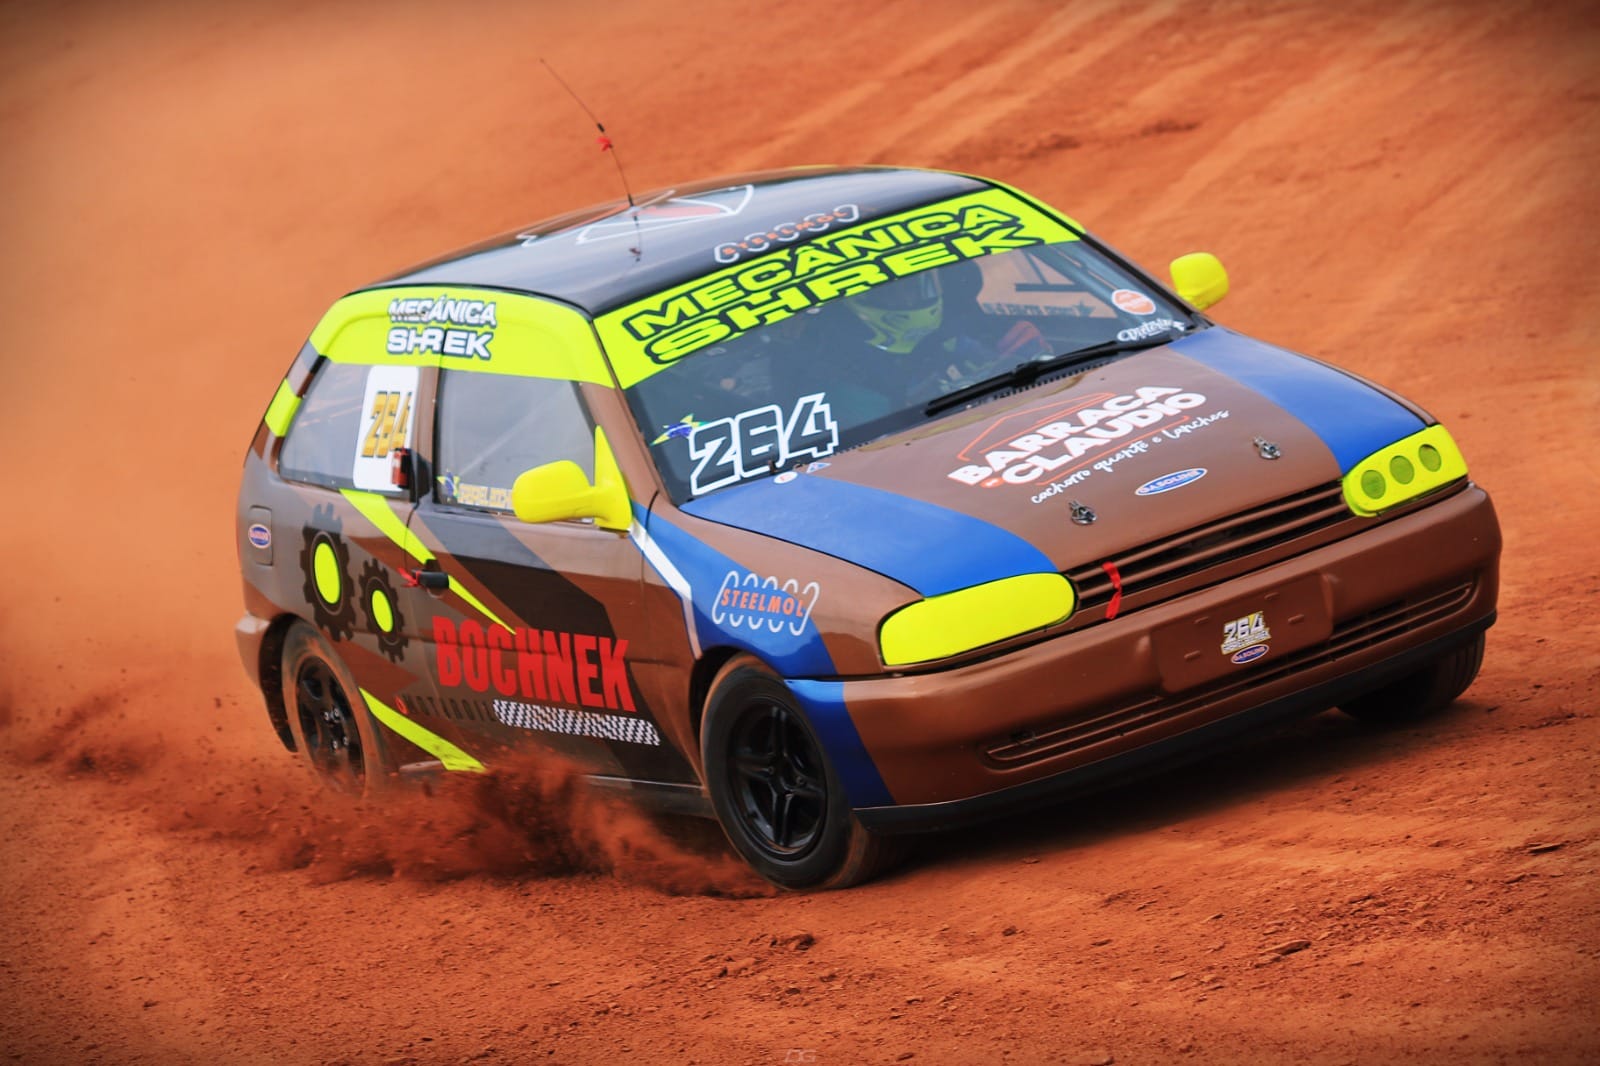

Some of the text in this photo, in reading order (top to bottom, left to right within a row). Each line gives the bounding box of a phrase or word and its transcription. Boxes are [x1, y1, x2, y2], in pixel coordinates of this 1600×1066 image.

[643, 221, 1048, 366] SHREK
[387, 327, 494, 361] SHREK
[688, 392, 839, 496] 264
[948, 385, 1182, 486] BARRACA
[1001, 392, 1206, 484] CLAUDIO
[1093, 440, 1149, 472] quente
[1161, 409, 1230, 439] lanches
[721, 588, 805, 618] STEELMOL
[1223, 611, 1266, 646] 264
[432, 615, 637, 713] BOCHNEK
